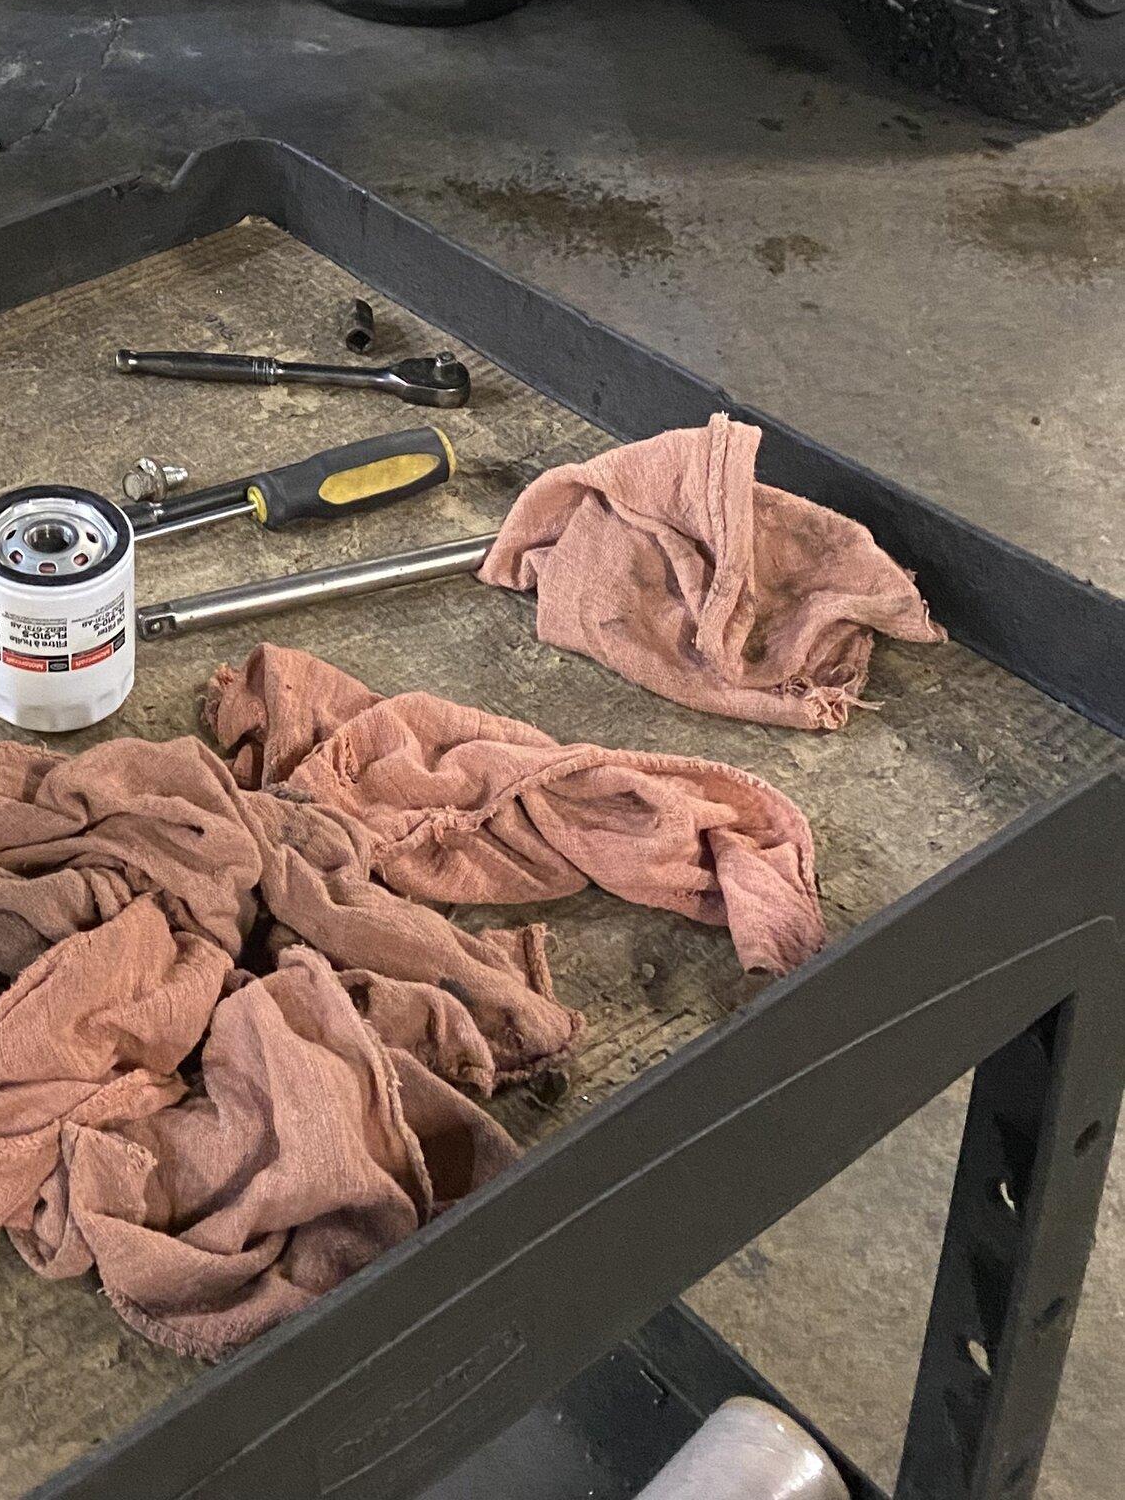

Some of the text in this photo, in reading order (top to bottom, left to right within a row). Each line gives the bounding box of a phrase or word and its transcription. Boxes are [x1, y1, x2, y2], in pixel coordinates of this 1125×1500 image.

[22, 630, 68, 640] FL-910-S
[96, 621, 117, 638] Filter
[9, 635, 68, 649] Filtre à huile
